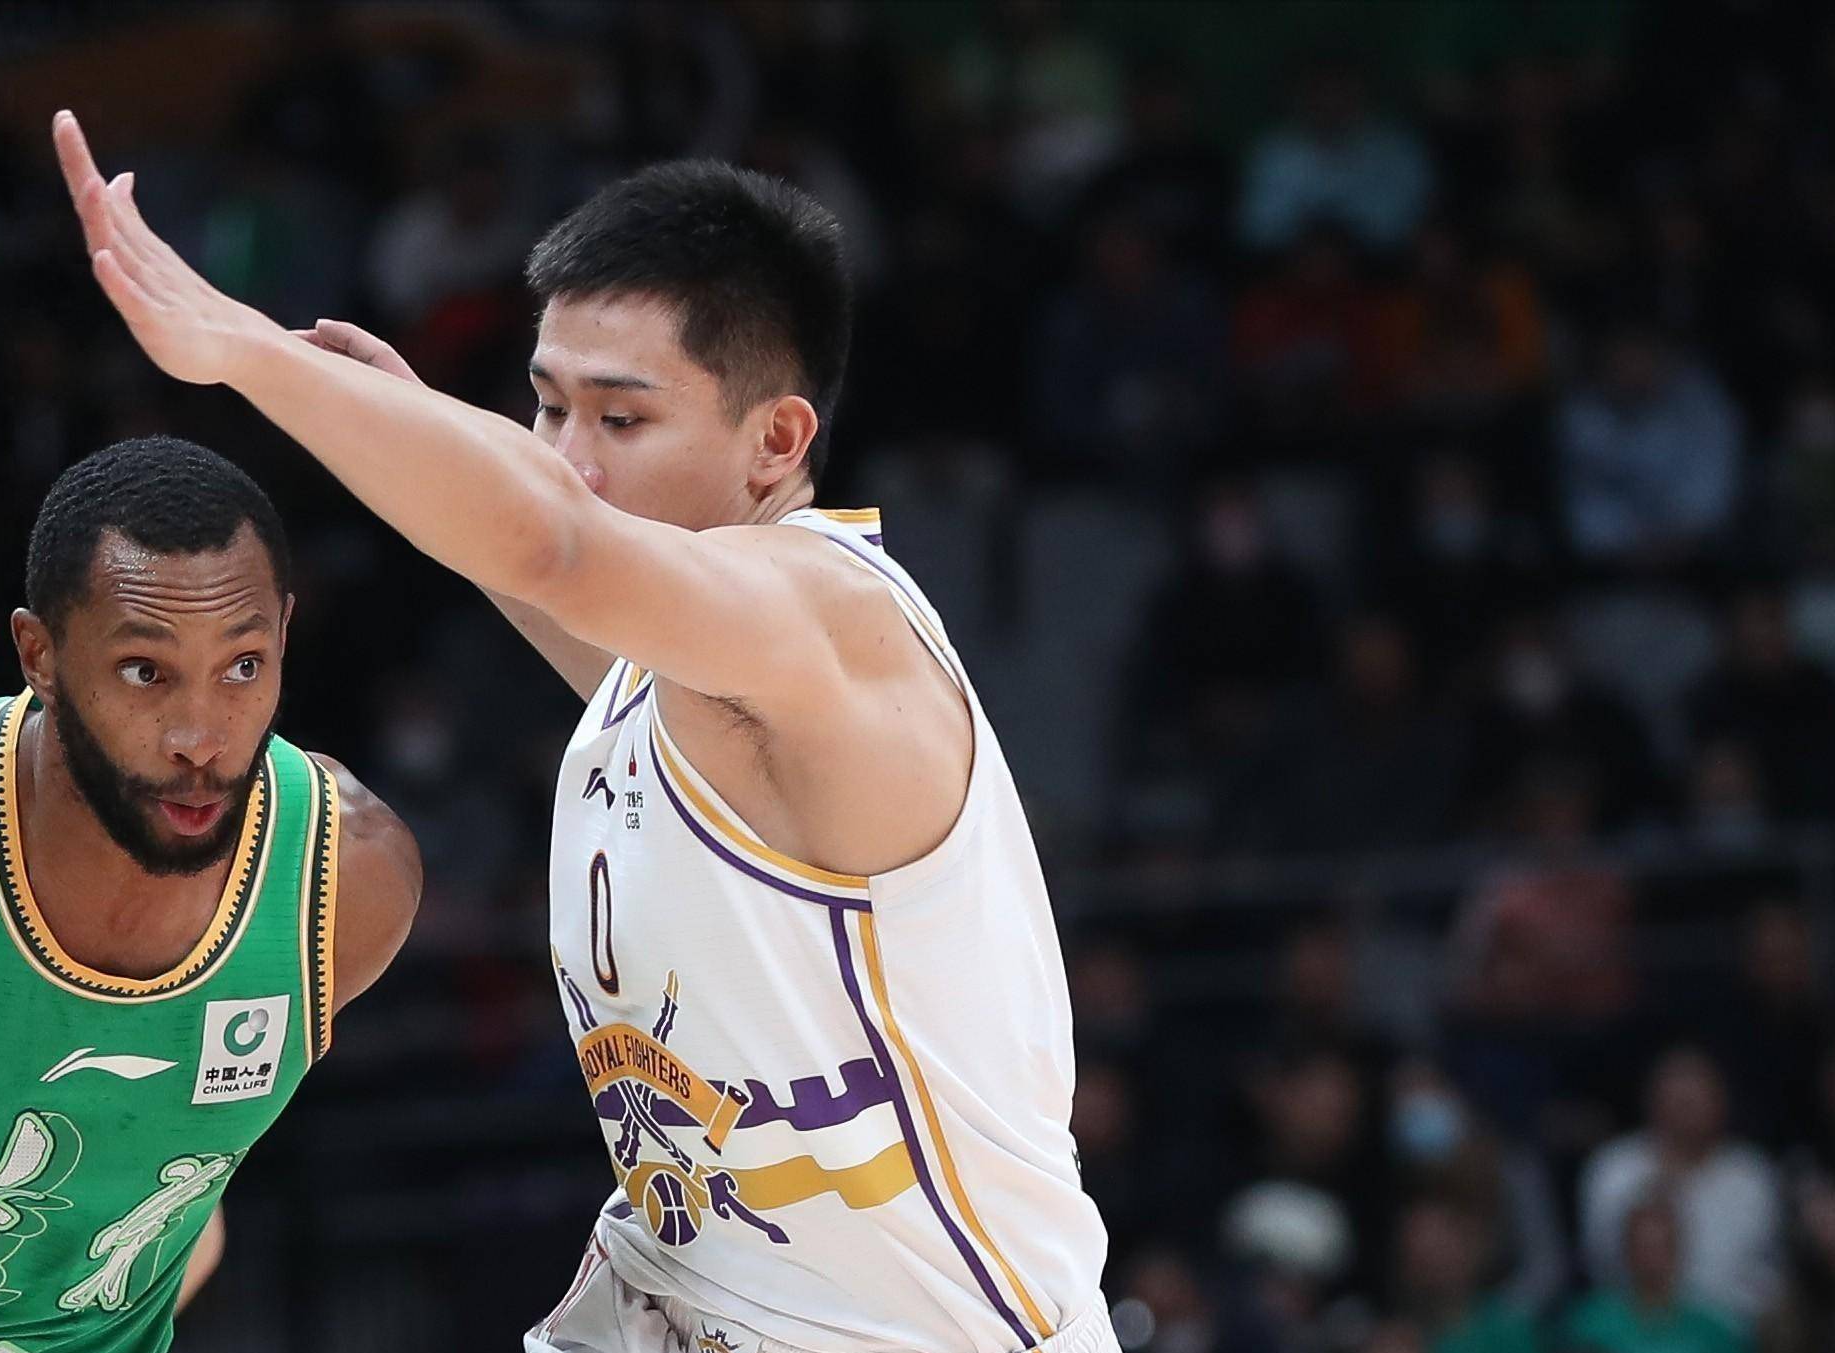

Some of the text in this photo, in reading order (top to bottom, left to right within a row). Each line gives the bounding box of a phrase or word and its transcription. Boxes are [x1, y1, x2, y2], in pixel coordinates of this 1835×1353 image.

[589, 849, 620, 997] 0
[203, 1079, 269, 1095] CHINA LIFE
[623, 1034, 691, 1100] FIGHTERS
